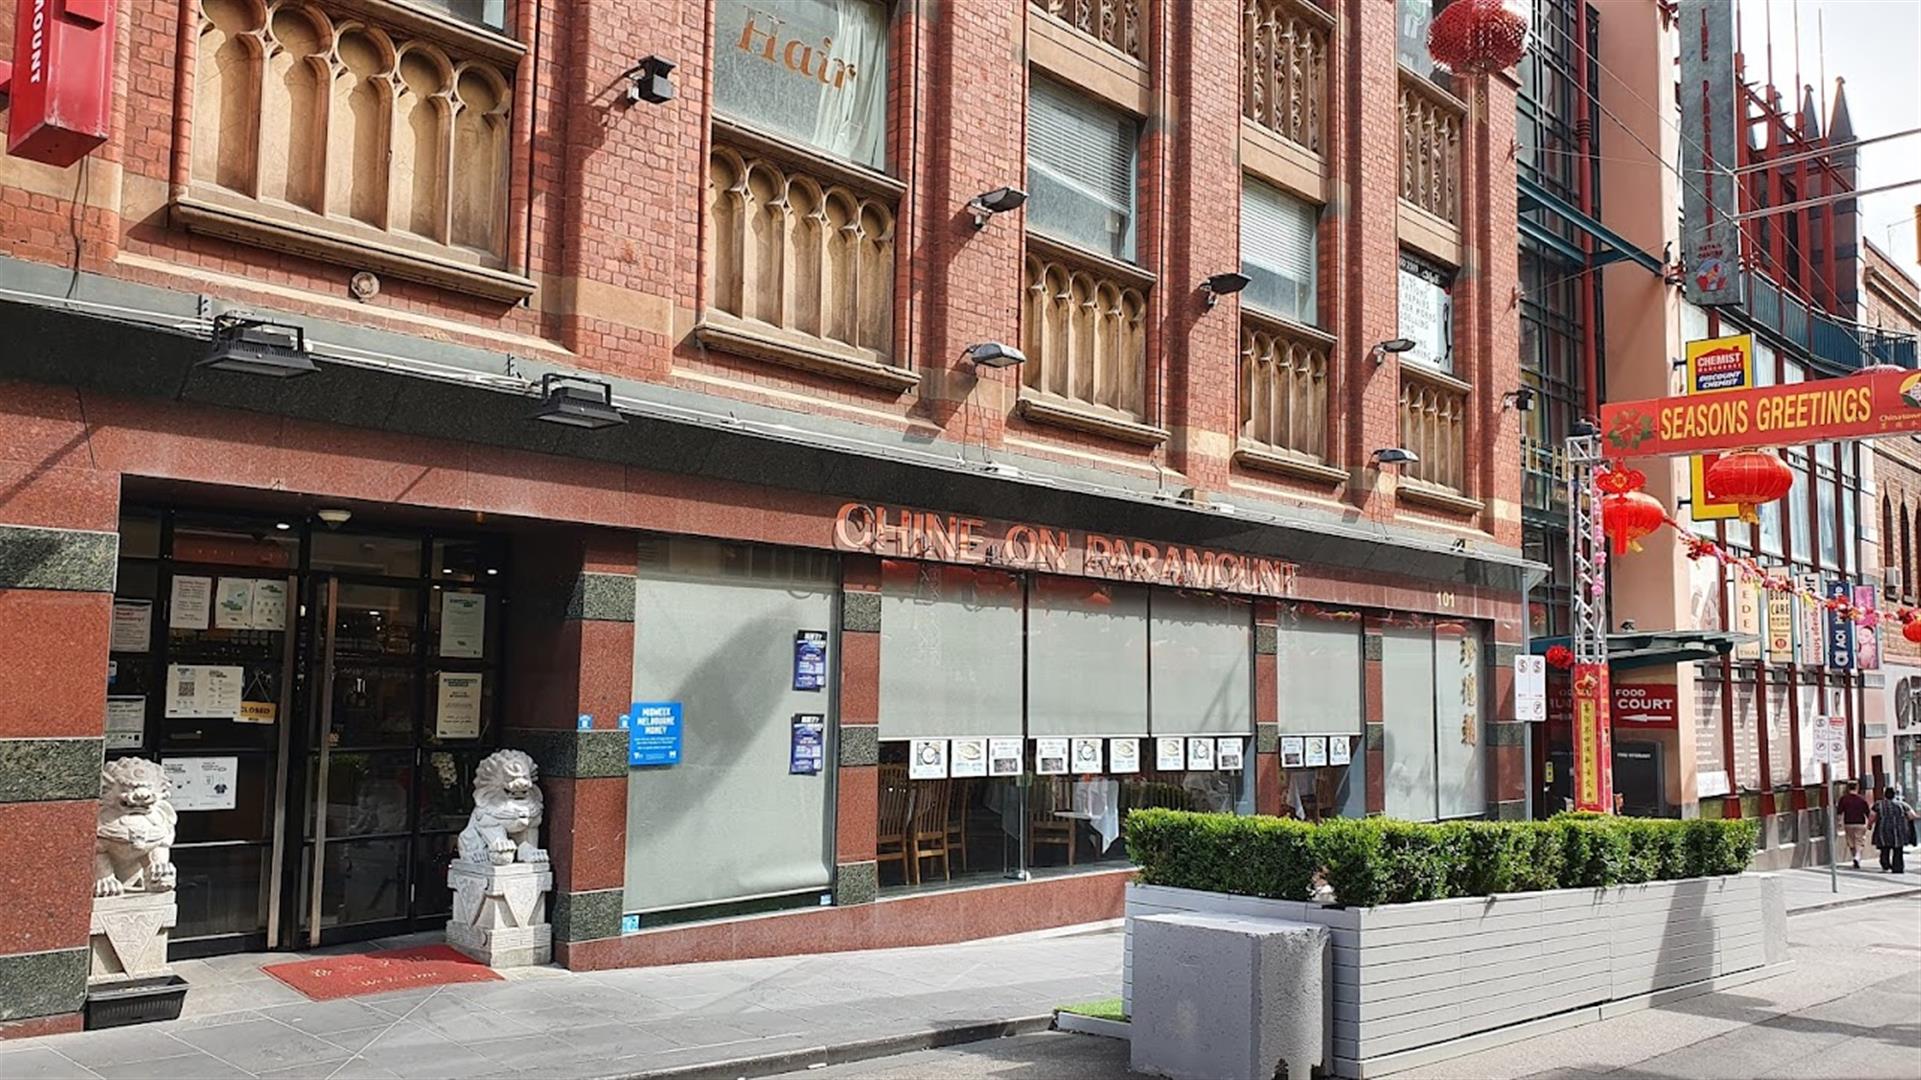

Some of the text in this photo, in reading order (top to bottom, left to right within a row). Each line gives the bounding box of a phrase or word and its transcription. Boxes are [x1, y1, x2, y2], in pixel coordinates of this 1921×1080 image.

[735, 5, 856, 88] Hair
[1697, 352, 1741, 367] CHEMIST
[1699, 371, 1741, 382] DISCOUNT
[1702, 379, 1738, 389] CHEMIST
[1660, 387, 1871, 440] SEASONS GREETINGS
[1004, 525, 1069, 569] ON
[1085, 534, 1300, 596] PARAMOUNT
[1436, 592, 1455, 608] 101
[1771, 603, 1789, 616] CARE
[1835, 630, 1846, 649] AOI
[1615, 689, 1646, 697] FOOD
[1617, 698, 1673, 710] COURT
[637, 716, 675, 726] MELBOURNE
[645, 726, 667, 735] MONEY
